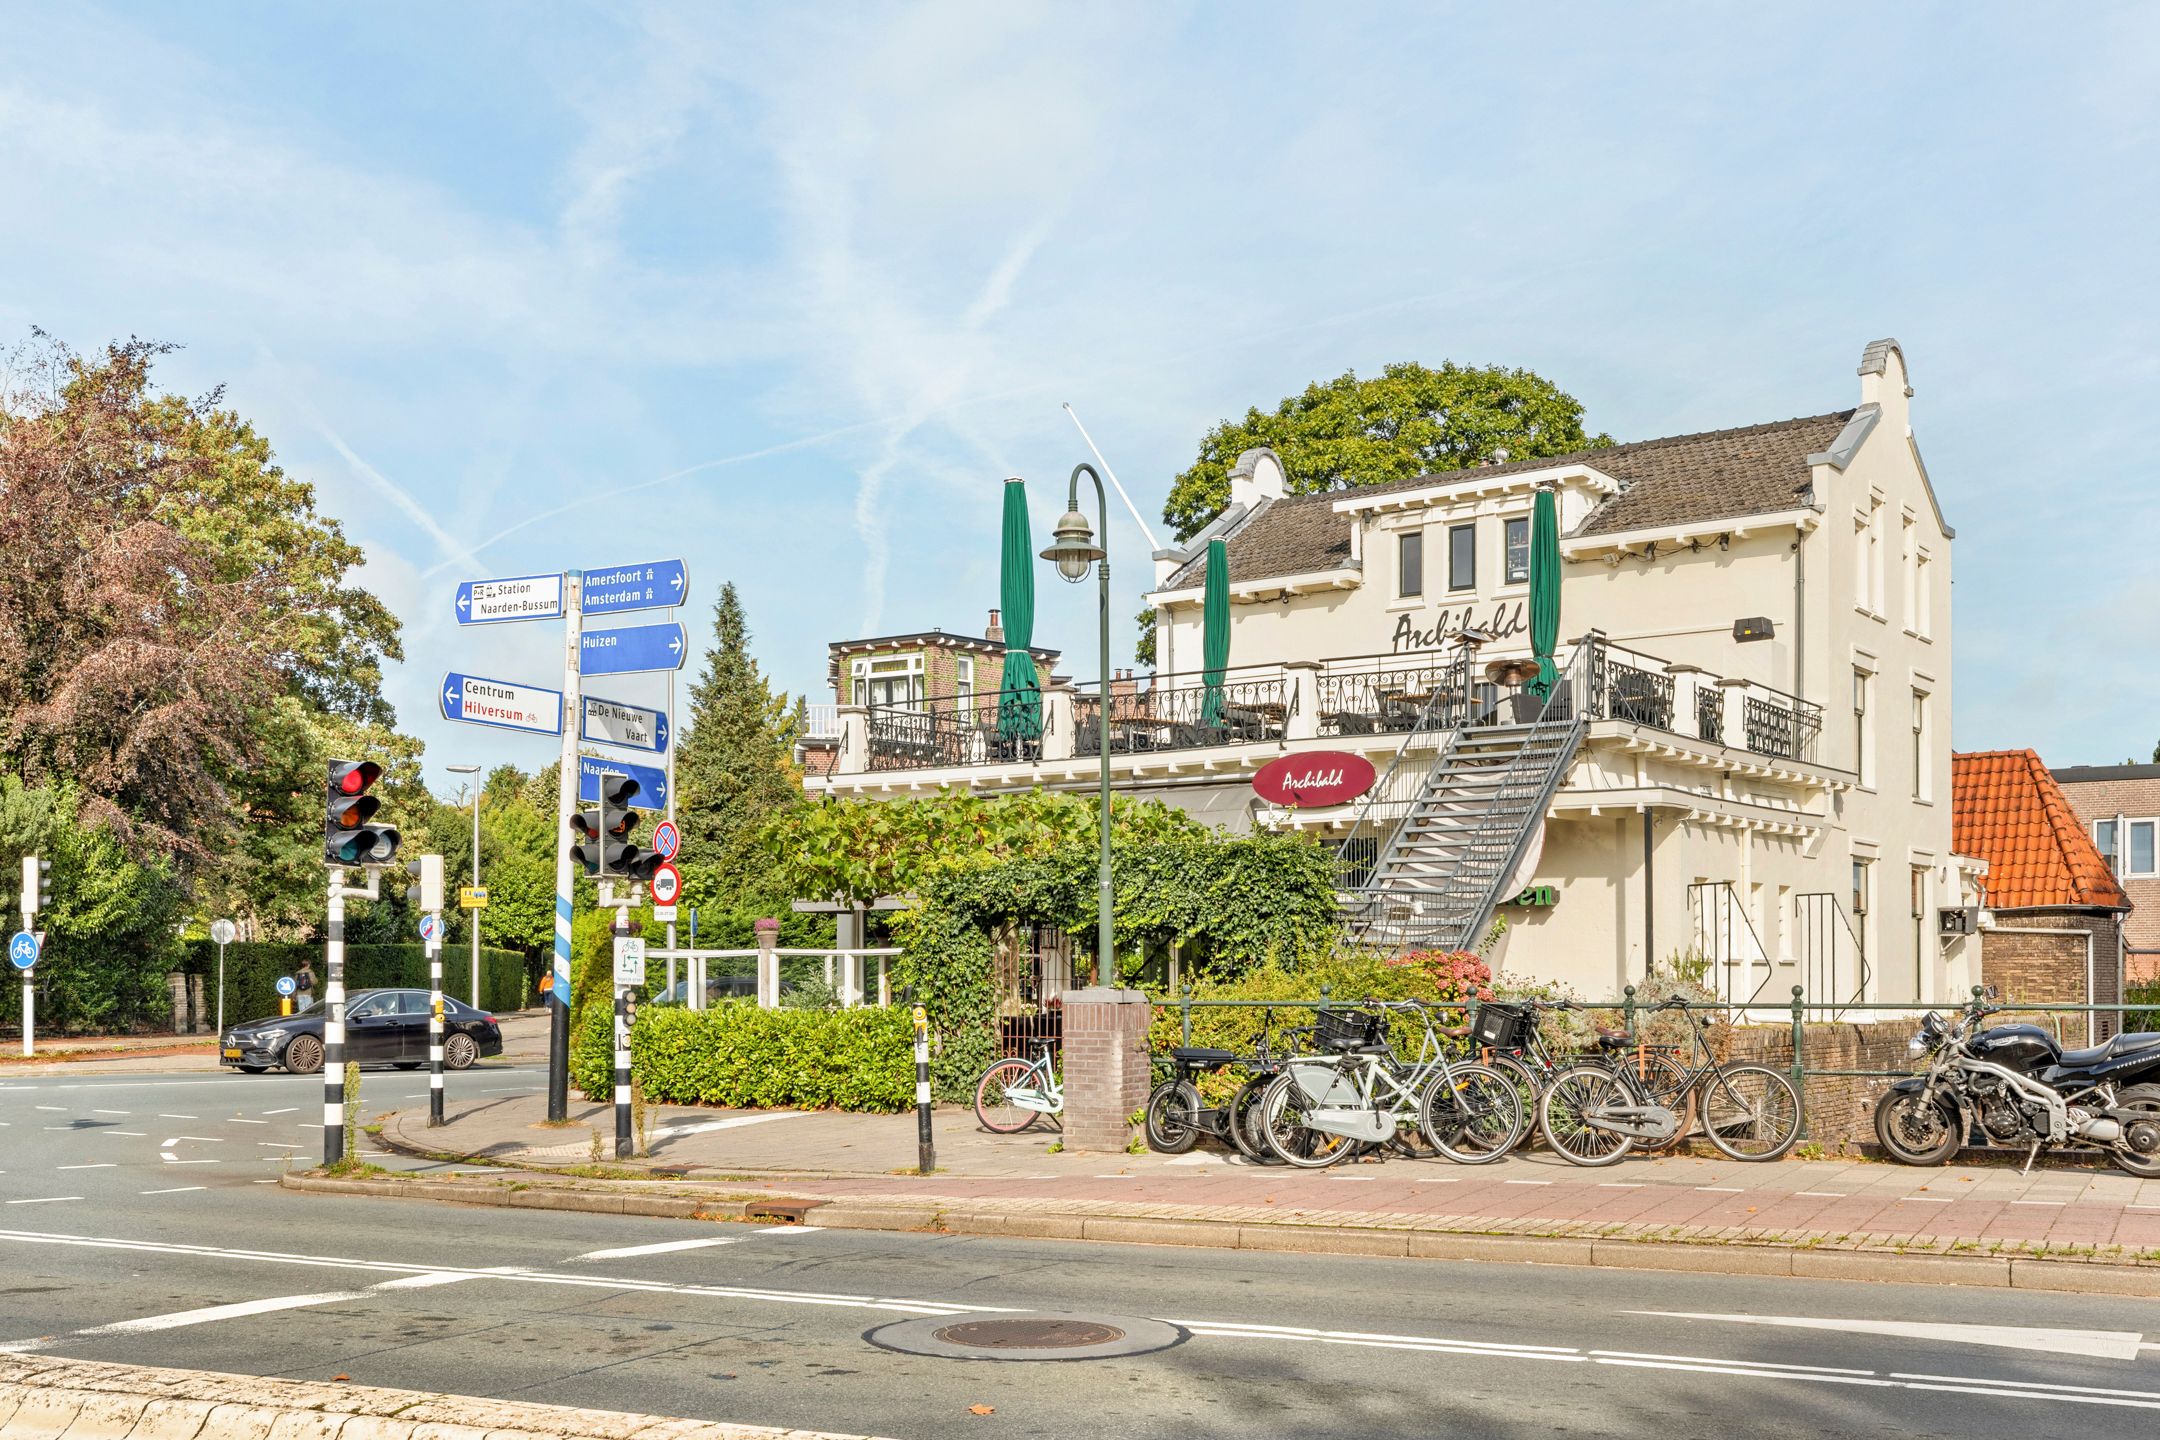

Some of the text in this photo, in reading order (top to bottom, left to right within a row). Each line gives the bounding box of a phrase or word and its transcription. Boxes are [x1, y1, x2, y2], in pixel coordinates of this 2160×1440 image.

[585, 570, 641, 587] Amersfoort
[498, 583, 531, 595] Station
[584, 590, 641, 606] Amsterdam
[480, 599, 558, 614] Naarden-Bussum
[583, 635, 617, 649] Huizen
[464, 681, 515, 700] Centrum
[464, 701, 523, 721] Hilversum
[598, 704, 643, 724] De Nieuwe
[626, 728, 648, 743] Vaart
[1282, 769, 1343, 791] Archibald
